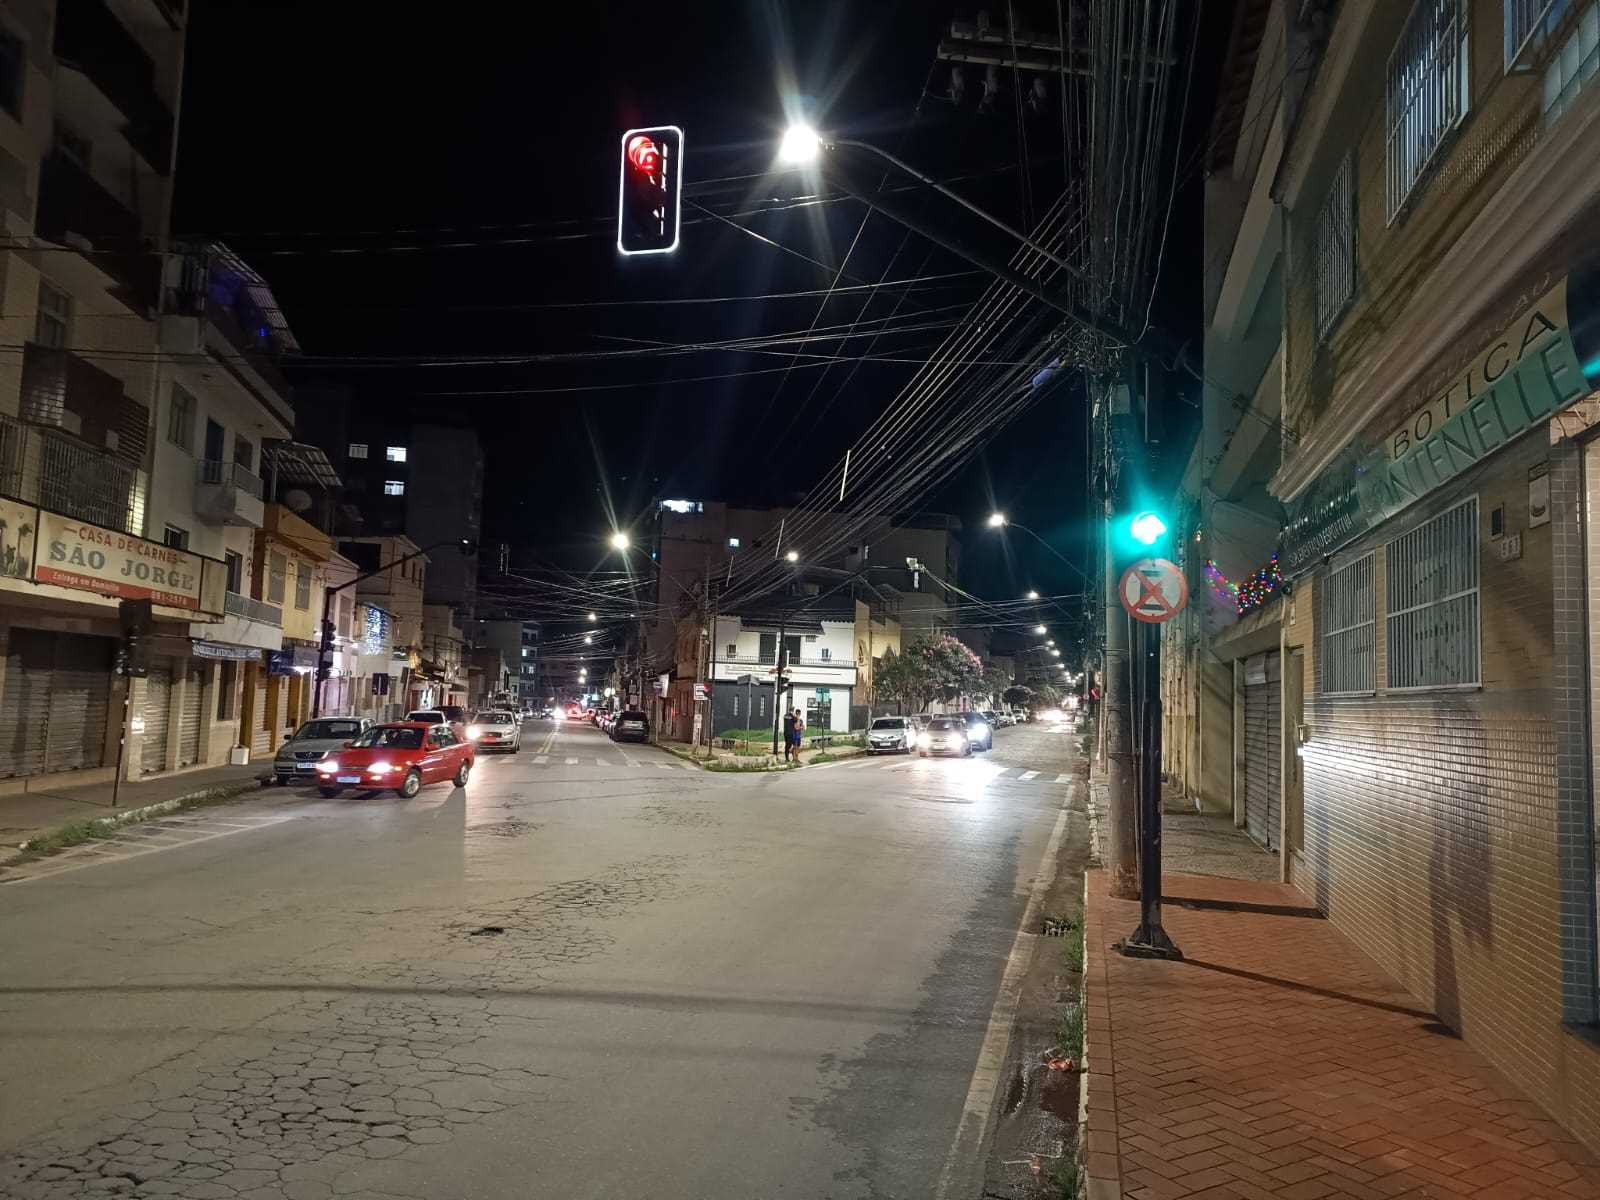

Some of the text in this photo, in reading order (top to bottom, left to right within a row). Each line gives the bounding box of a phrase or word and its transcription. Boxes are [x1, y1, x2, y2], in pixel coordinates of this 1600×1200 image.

[1393, 310, 1558, 459] BOTICA
[49, 540, 195, 591] SÃO JORGE
[79, 526, 178, 564] CASA DE CARNES
